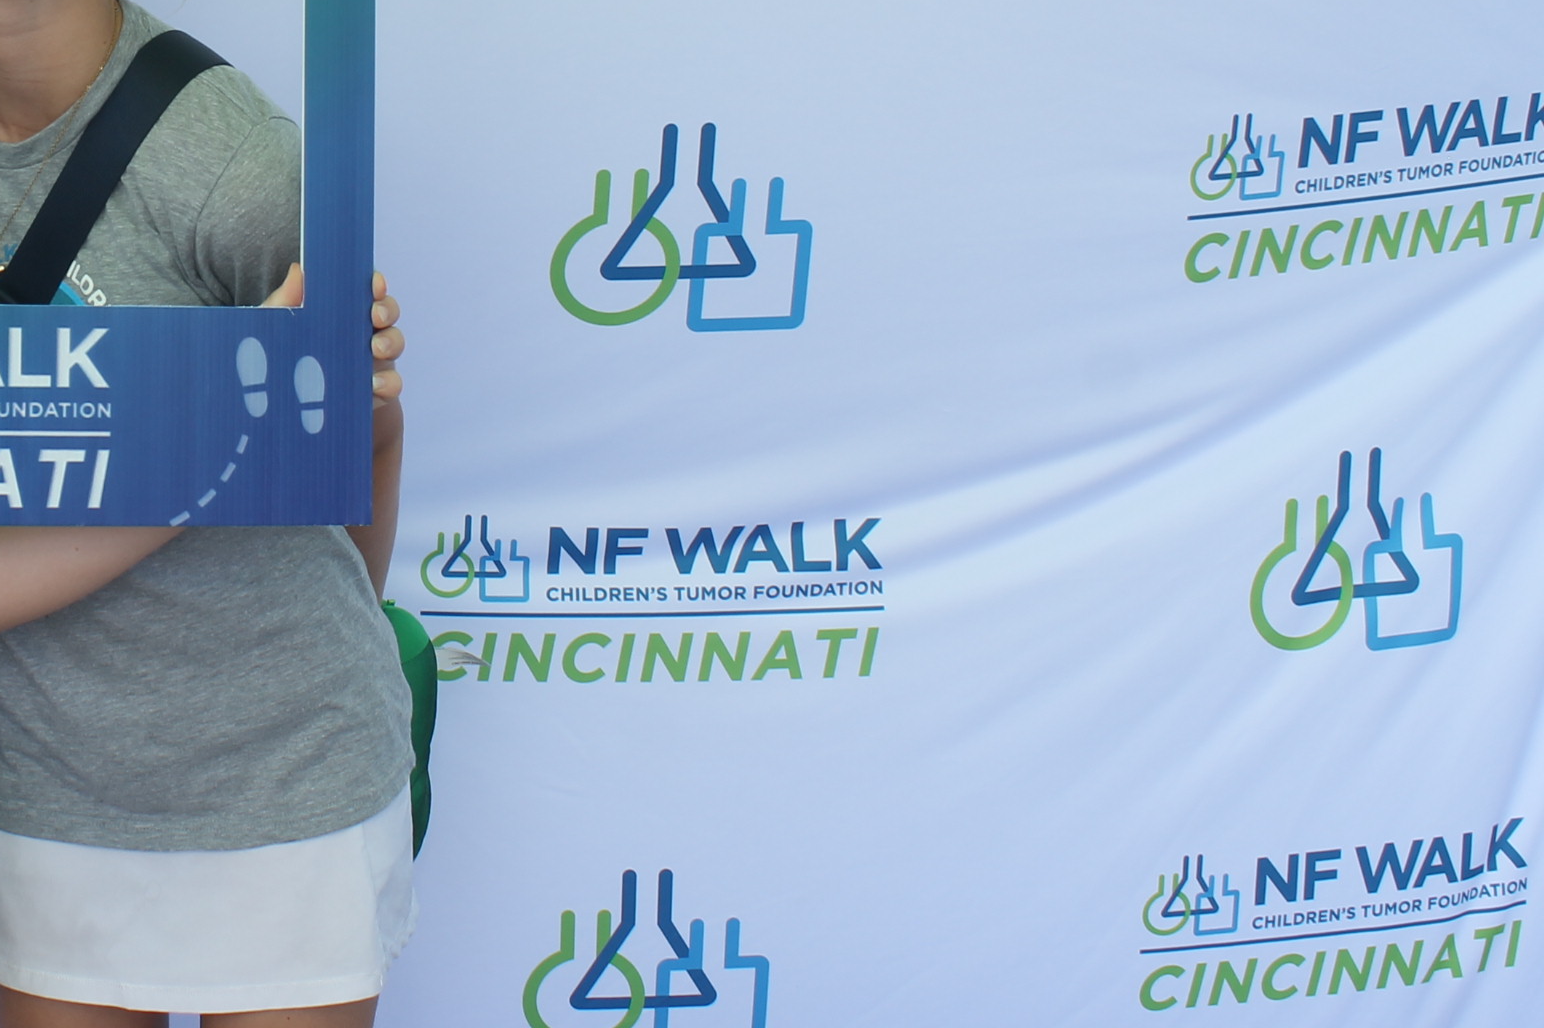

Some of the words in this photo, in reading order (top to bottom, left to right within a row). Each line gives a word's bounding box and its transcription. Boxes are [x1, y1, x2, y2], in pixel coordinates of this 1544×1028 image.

[1297, 109, 1384, 169] NF
[1295, 170, 1393, 194] CHILDREN'S
[1397, 160, 1454, 182] TUMOR
[1184, 192, 1544, 284] CINCINNATI
[546, 526, 649, 575] NF
[665, 517, 883, 575] WALK
[546, 585, 668, 603] CHILDREN'S
[673, 585, 746, 601] TUMOR
[752, 580, 884, 600] FOUNDATION
[432, 626, 879, 683] CINCINNATI
[1254, 848, 1342, 906] NF
[1355, 816, 1528, 894] WALK
[1252, 906, 1356, 930] CHILDREN'S
[1361, 898, 1422, 919] TUMOR
[1427, 877, 1528, 911] FOUNDATION
[1139, 920, 1522, 1012] CINCINNATI
